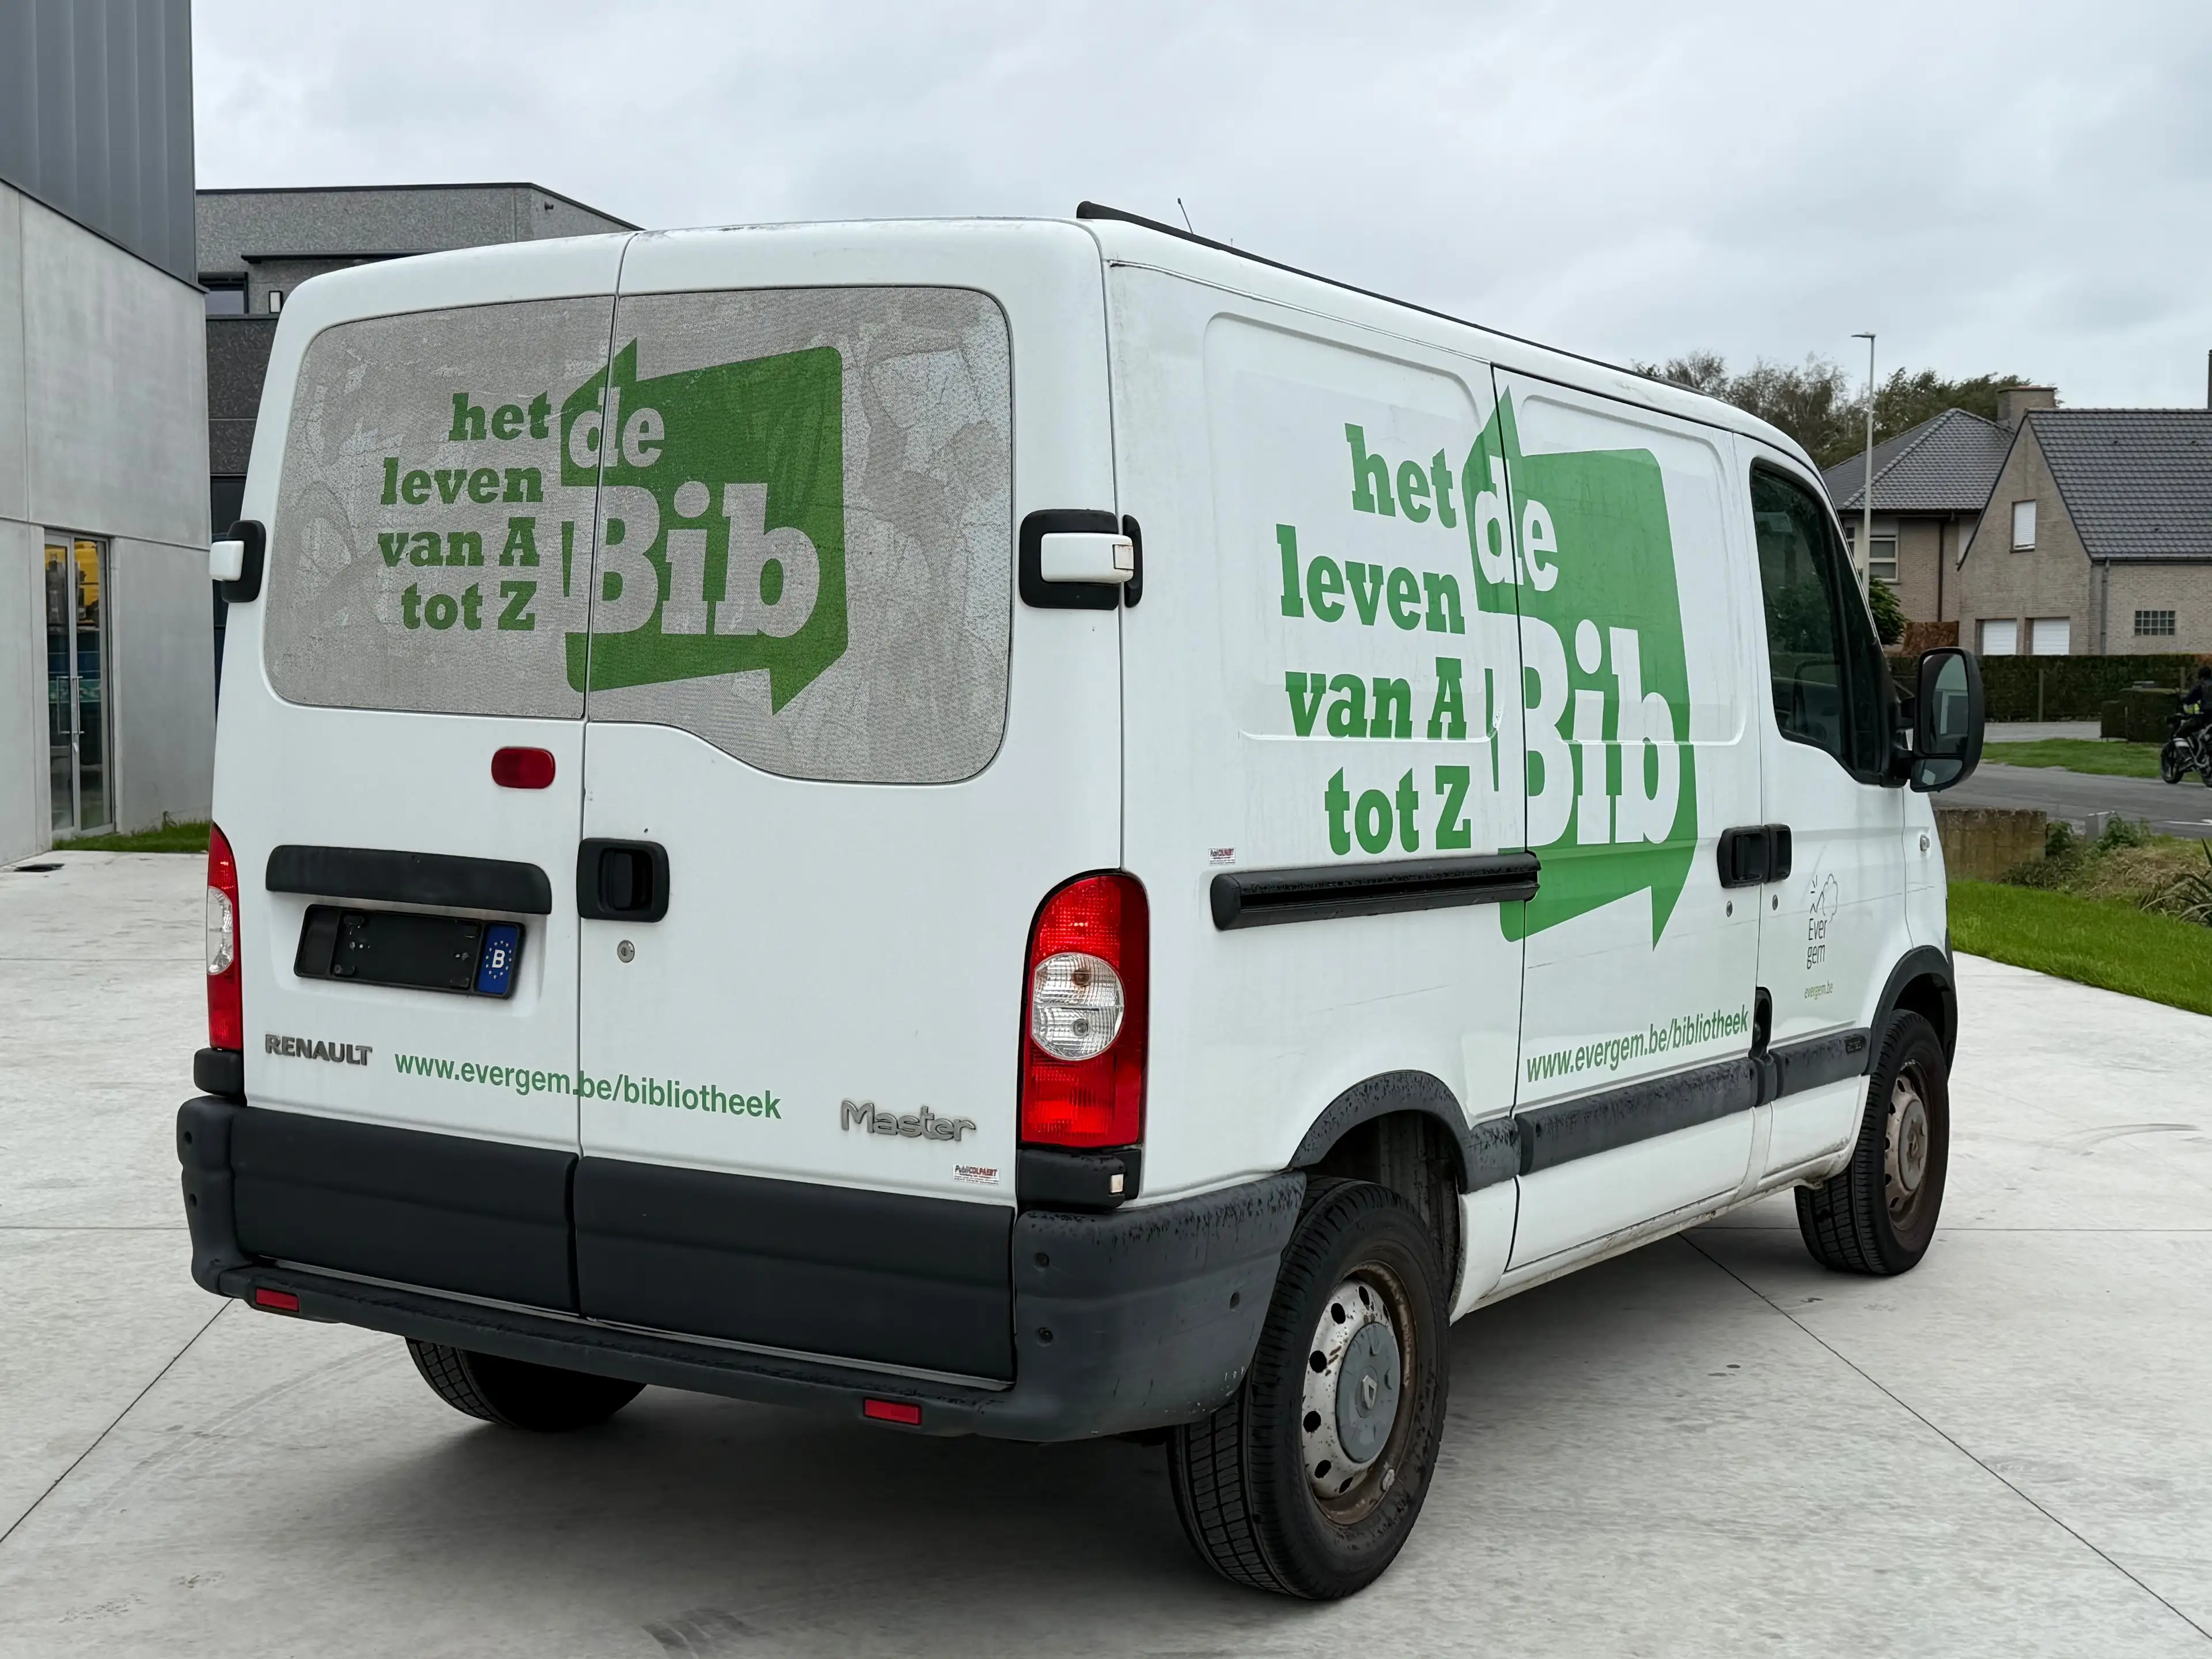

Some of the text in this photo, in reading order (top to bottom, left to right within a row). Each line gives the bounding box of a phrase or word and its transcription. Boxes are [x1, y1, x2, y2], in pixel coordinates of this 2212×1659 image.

[448, 391, 551, 441] het
[568, 387, 666, 468] de
[380, 457, 544, 505] leven
[1344, 422, 1457, 529] het
[377, 516, 540, 567] van A
[1474, 454, 1559, 592] de
[560, 481, 820, 638] Bib
[1276, 523, 1465, 635] leven
[401, 580, 537, 631] tot Z
[1286, 657, 1467, 740] van A
[1480, 612, 1681, 847] Bib
[1324, 765, 1472, 856] tot Z
[491, 949, 505, 968] B
[1806, 944, 1825, 970] gem
[1808, 918, 1828, 941] Ever
[1804, 979, 1834, 1000] evergem.be
[264, 1034, 373, 1066] RENAULT
[1527, 1004, 1749, 1082] www.evergem.be/bibliotheek
[395, 1053, 782, 1120] www.evergem.be/bibliotheek
[841, 1100, 976, 1141] Master
